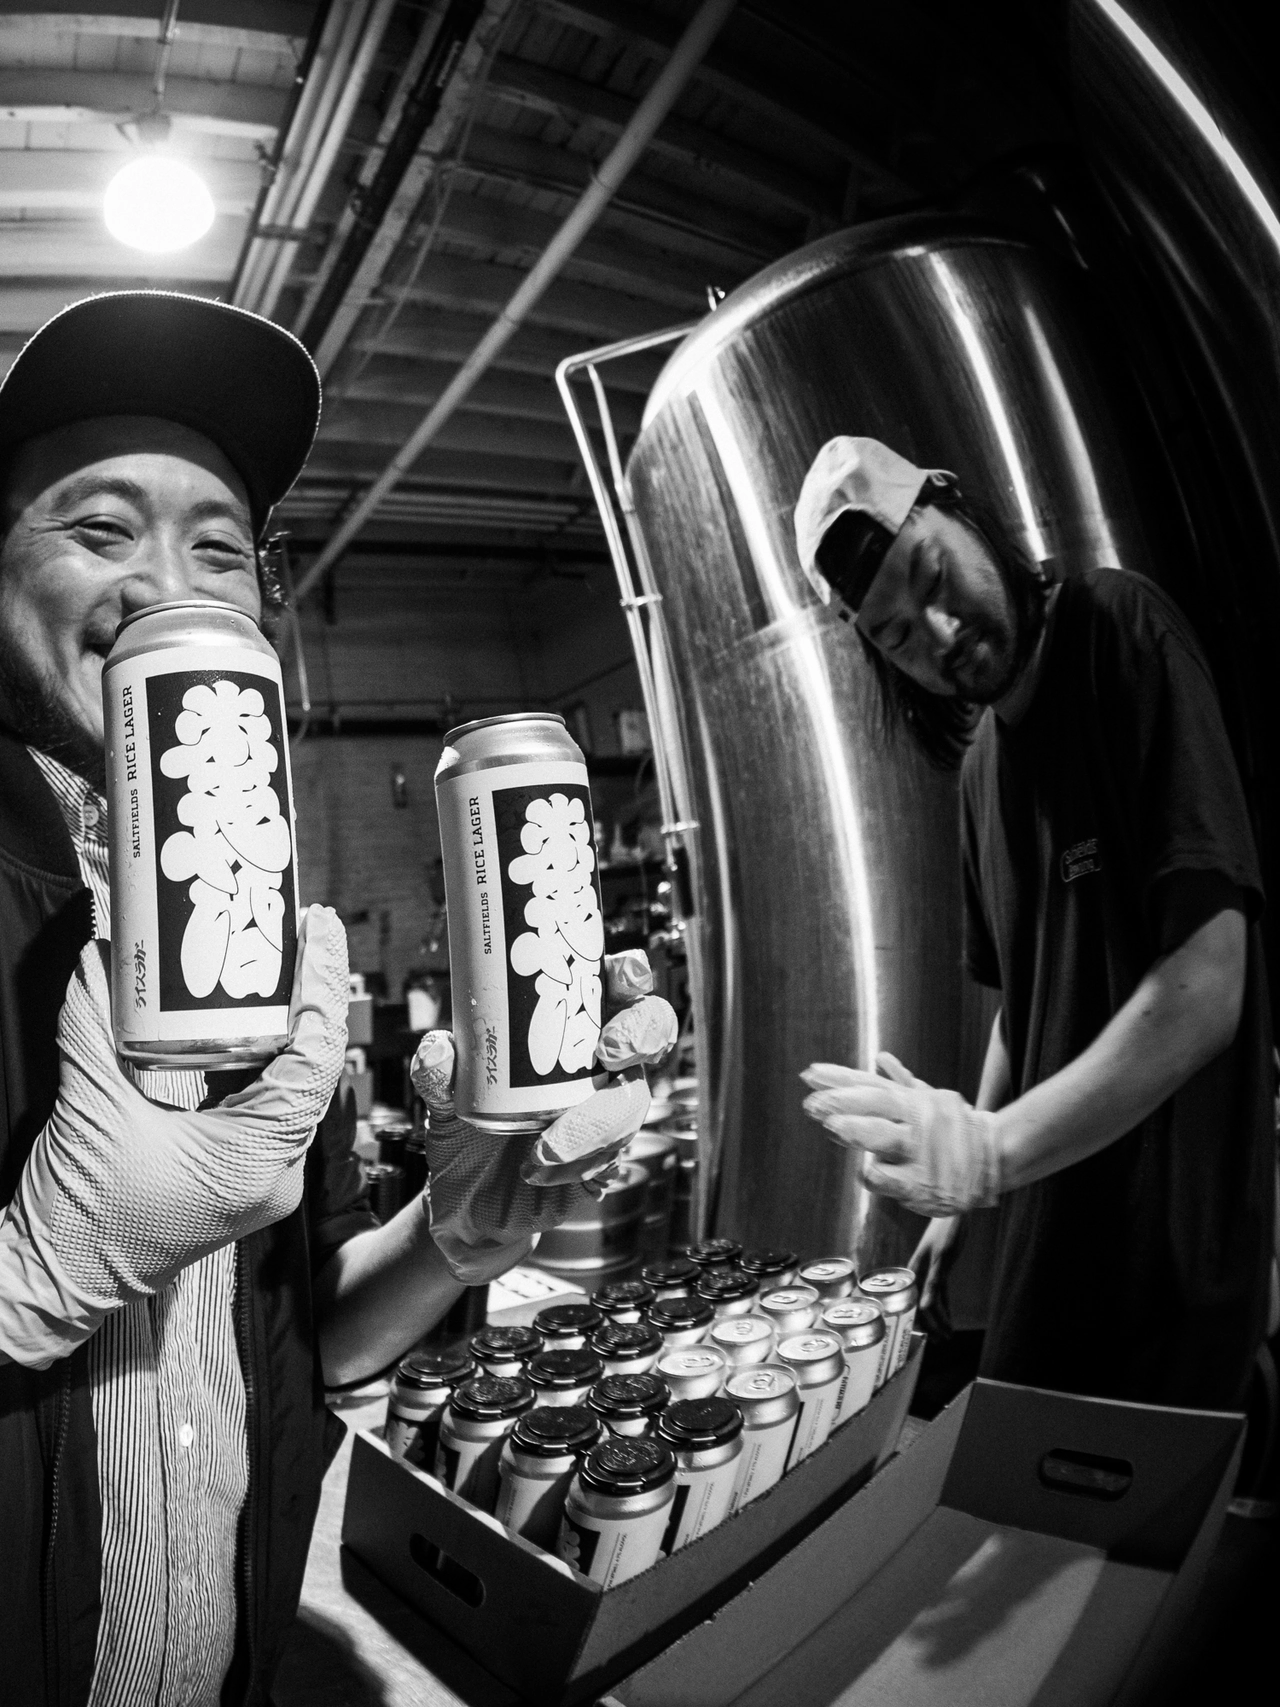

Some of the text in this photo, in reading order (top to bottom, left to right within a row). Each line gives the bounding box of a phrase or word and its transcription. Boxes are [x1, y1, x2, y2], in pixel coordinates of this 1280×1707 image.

[122, 685, 141, 859] SALTFIELDS RICE LAGER
[469, 796, 492, 955] SALTFIELDS RICE LAGER
[134, 939, 147, 1009] ライスラガー
[485, 1026, 498, 1085] ライスラガー
